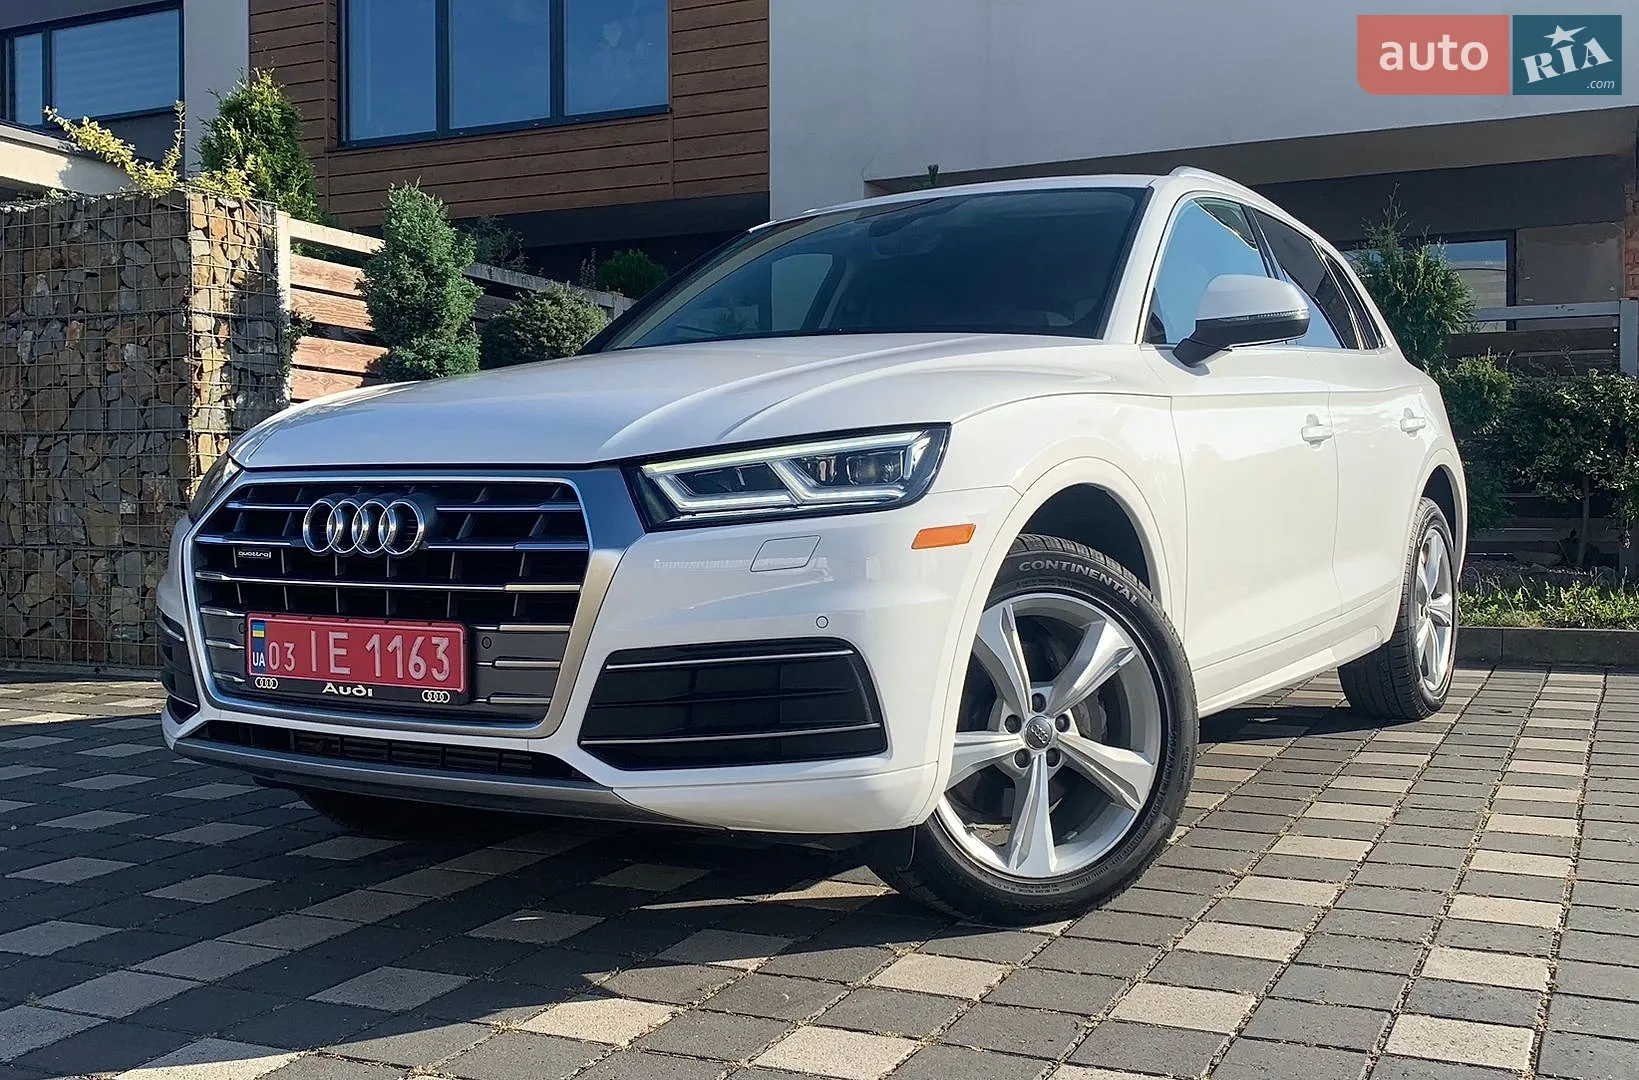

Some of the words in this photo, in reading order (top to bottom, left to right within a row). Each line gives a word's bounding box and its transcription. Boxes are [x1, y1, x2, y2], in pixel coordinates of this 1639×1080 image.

[1018, 560, 1139, 607] CONTINENTAL
[252, 651, 266, 667] UA
[268, 642, 296, 672] 03
[310, 630, 351, 675] IE
[365, 634, 450, 682] 1163
[322, 683, 373, 697] Audi
